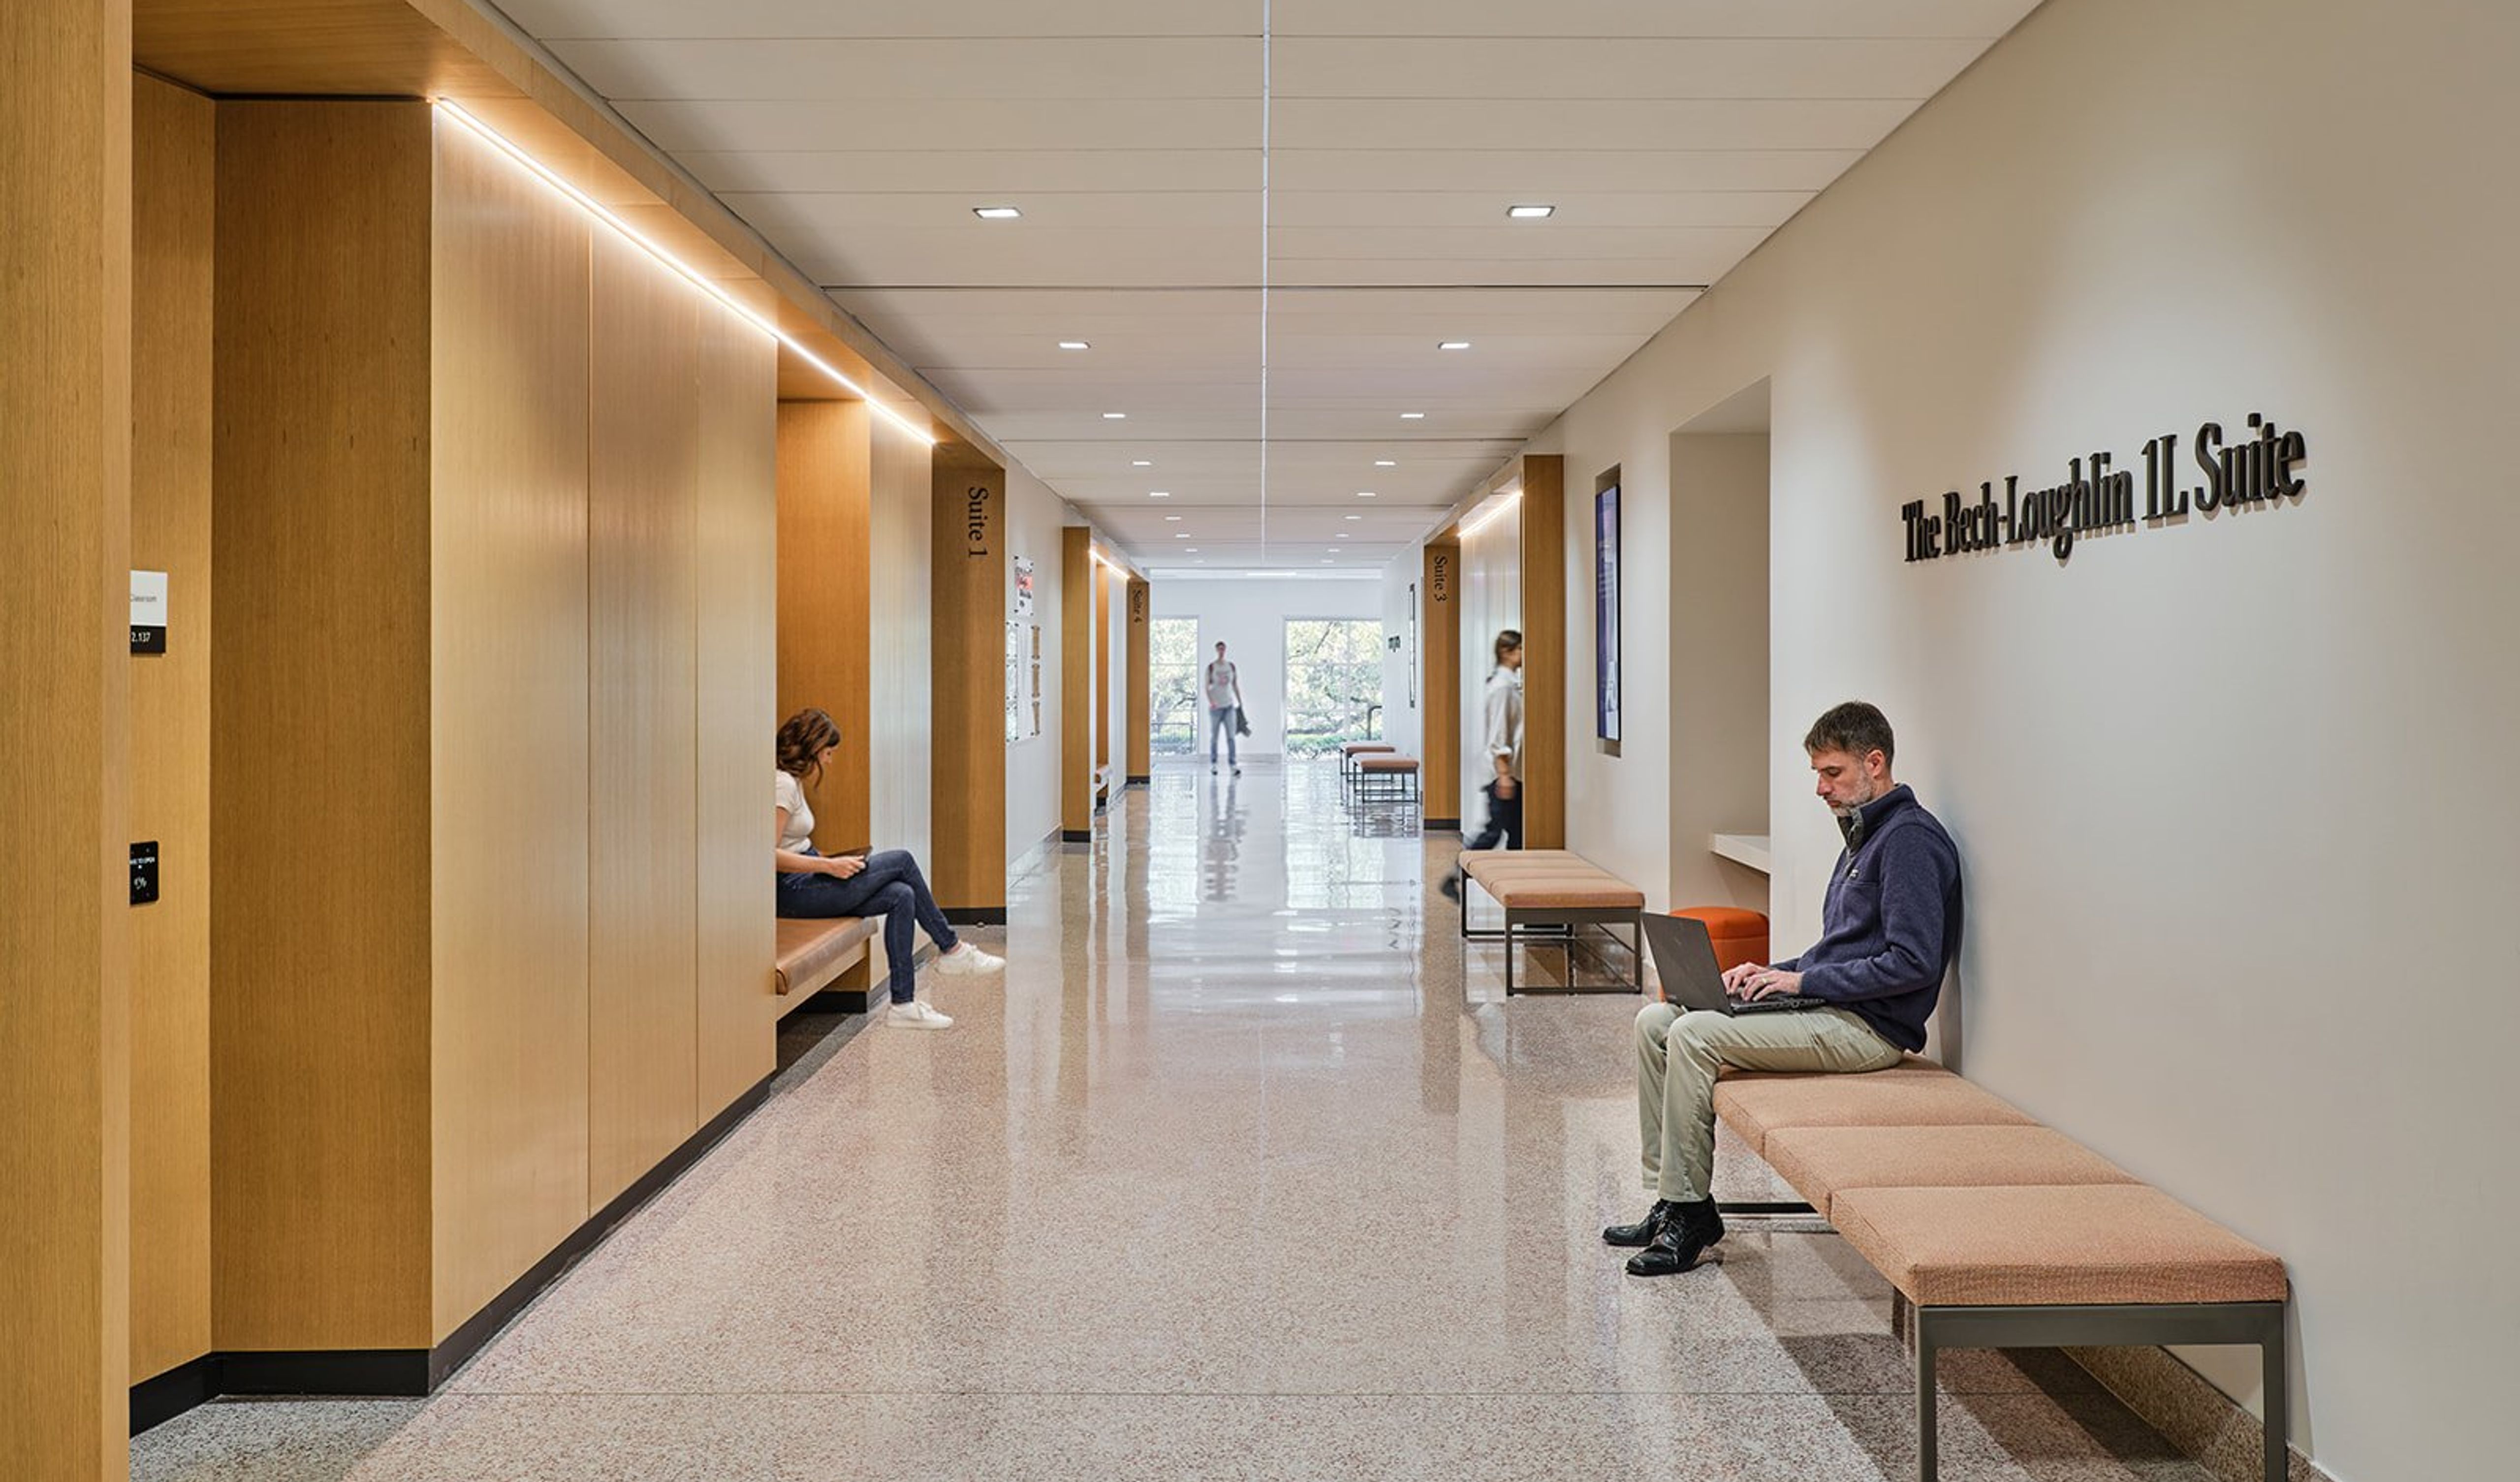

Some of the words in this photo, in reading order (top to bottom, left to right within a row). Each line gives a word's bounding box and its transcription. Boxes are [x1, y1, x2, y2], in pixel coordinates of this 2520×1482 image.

[1902, 499, 1941, 562] The
[1943, 451, 2135, 559] Bech-Loughlin
[2141, 434, 2188, 520] 1L
[2194, 412, 2305, 511] Suite
[968, 486, 989, 541] Suite
[968, 547, 988, 558] 1
[1434, 556, 1448, 590] Suite
[1434, 594, 1448, 602] 3
